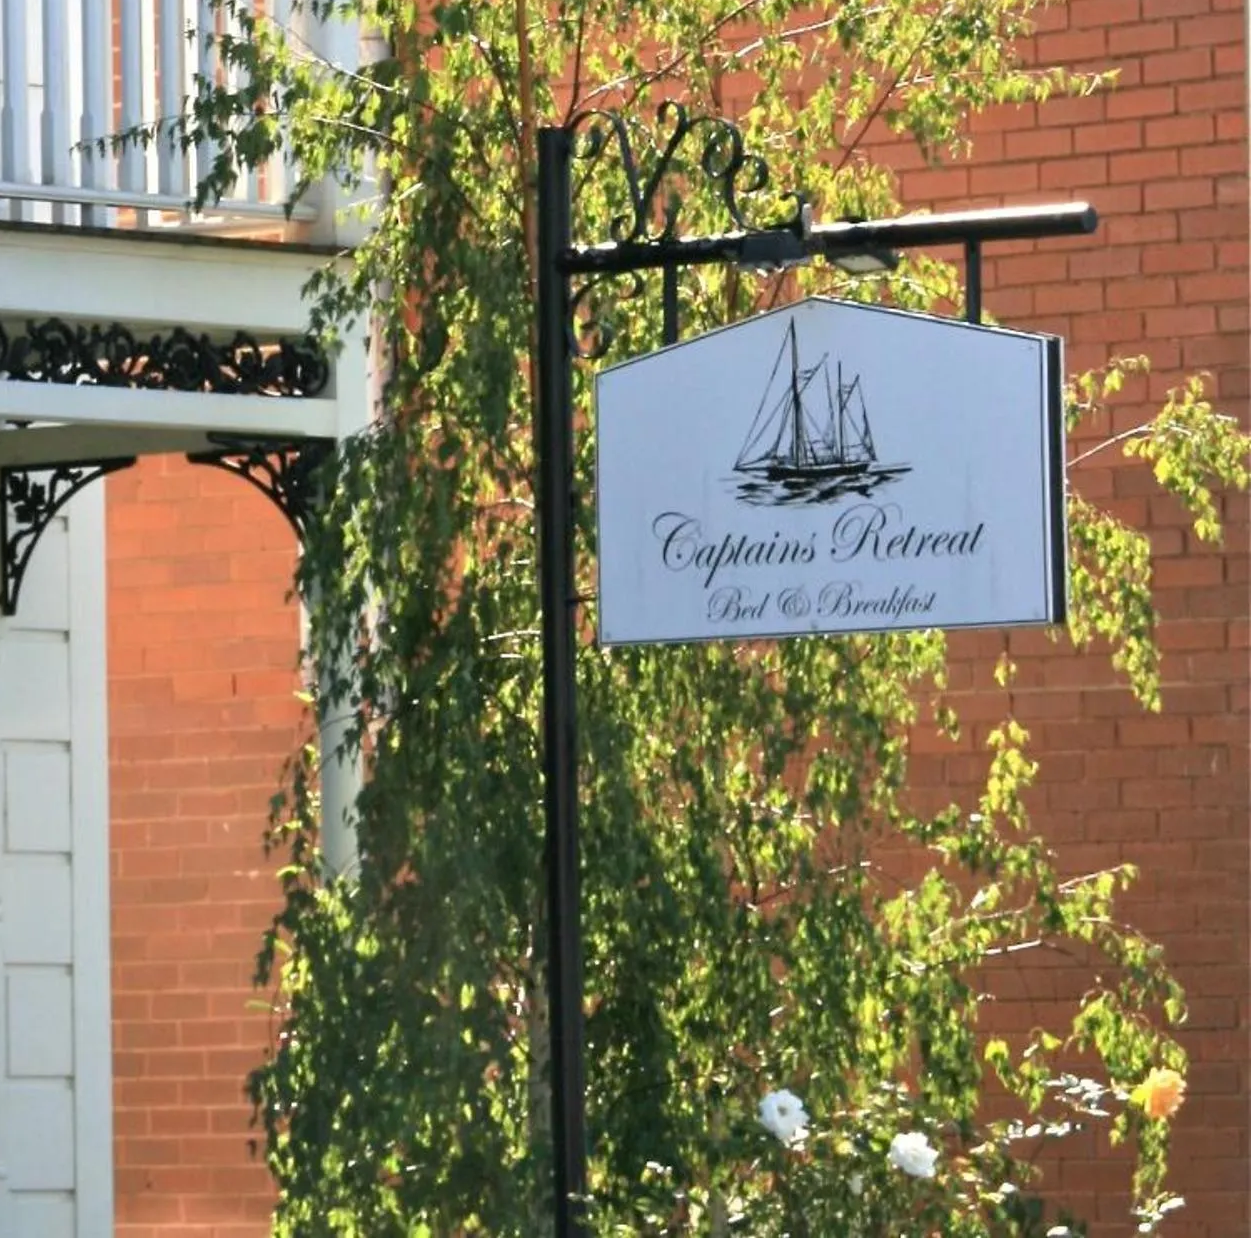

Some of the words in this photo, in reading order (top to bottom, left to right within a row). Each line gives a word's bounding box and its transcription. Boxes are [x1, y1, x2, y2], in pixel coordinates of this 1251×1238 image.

[830, 502, 984, 563] Retreat
[707, 586, 770, 623] Bed
[777, 586, 811, 617] &
[817, 580, 936, 619] Breakfast
